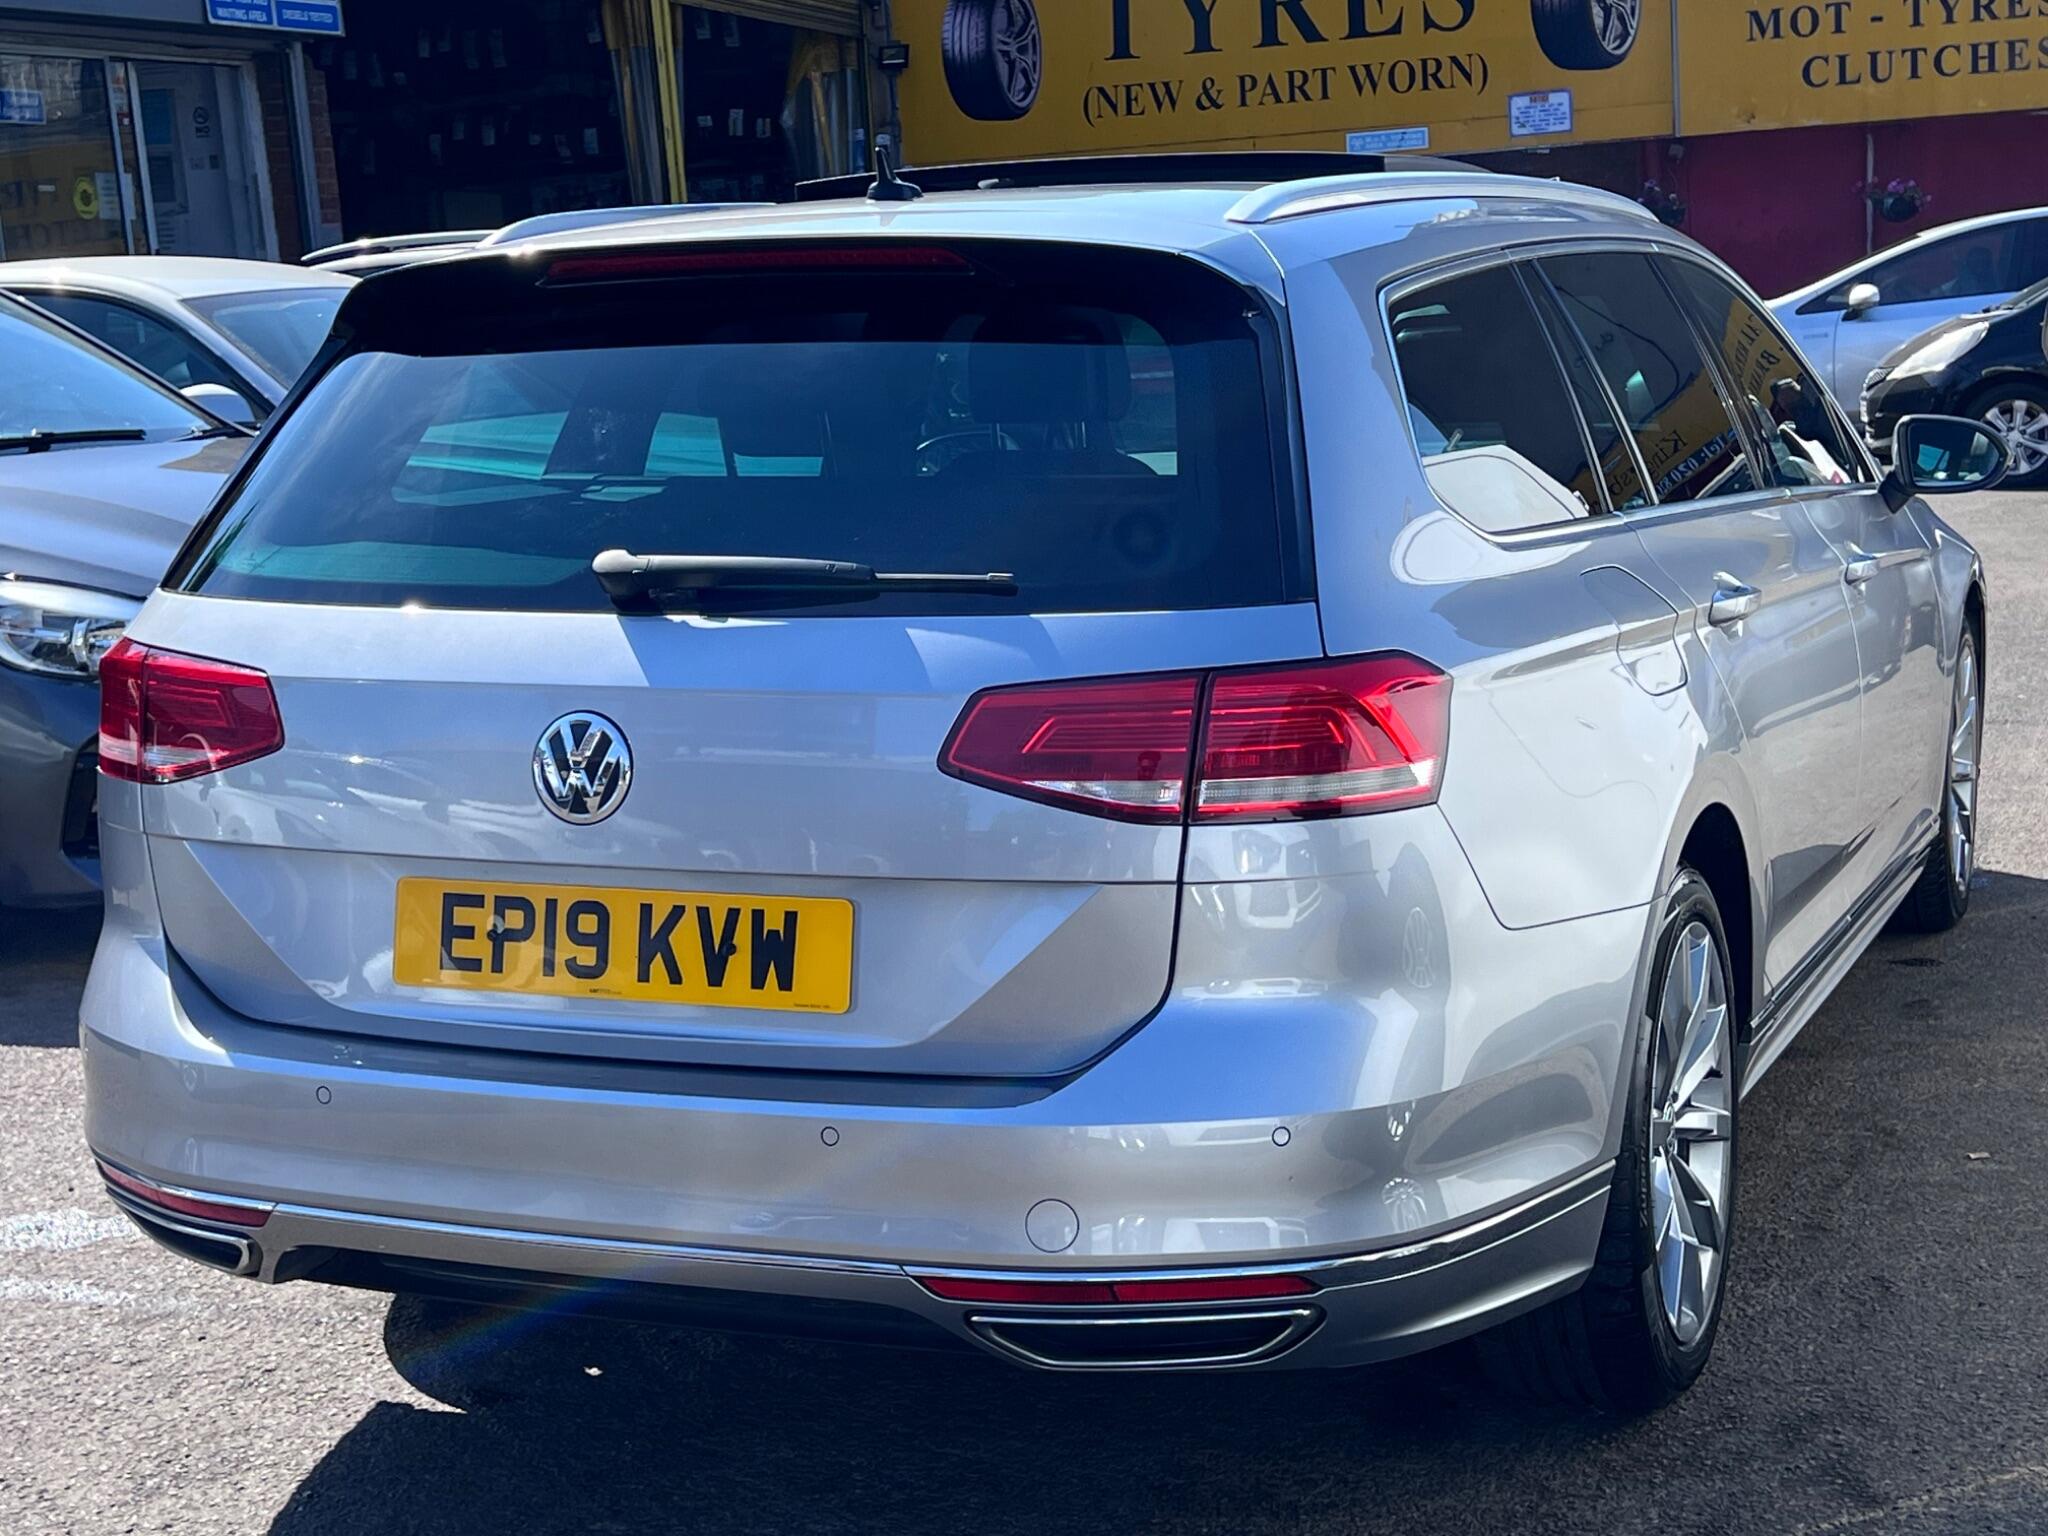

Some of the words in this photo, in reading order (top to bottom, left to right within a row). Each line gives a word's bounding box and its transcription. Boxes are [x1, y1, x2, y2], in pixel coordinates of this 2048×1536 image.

[1746, 2, 1852, 42] MOT
[1083, 79, 1184, 128] (NEW
[1195, 76, 1224, 111] &
[1236, 66, 1336, 108] PART
[1346, 53, 1489, 96] WORN)
[440, 892, 611, 980] EP19
[636, 902, 799, 992] KVW
